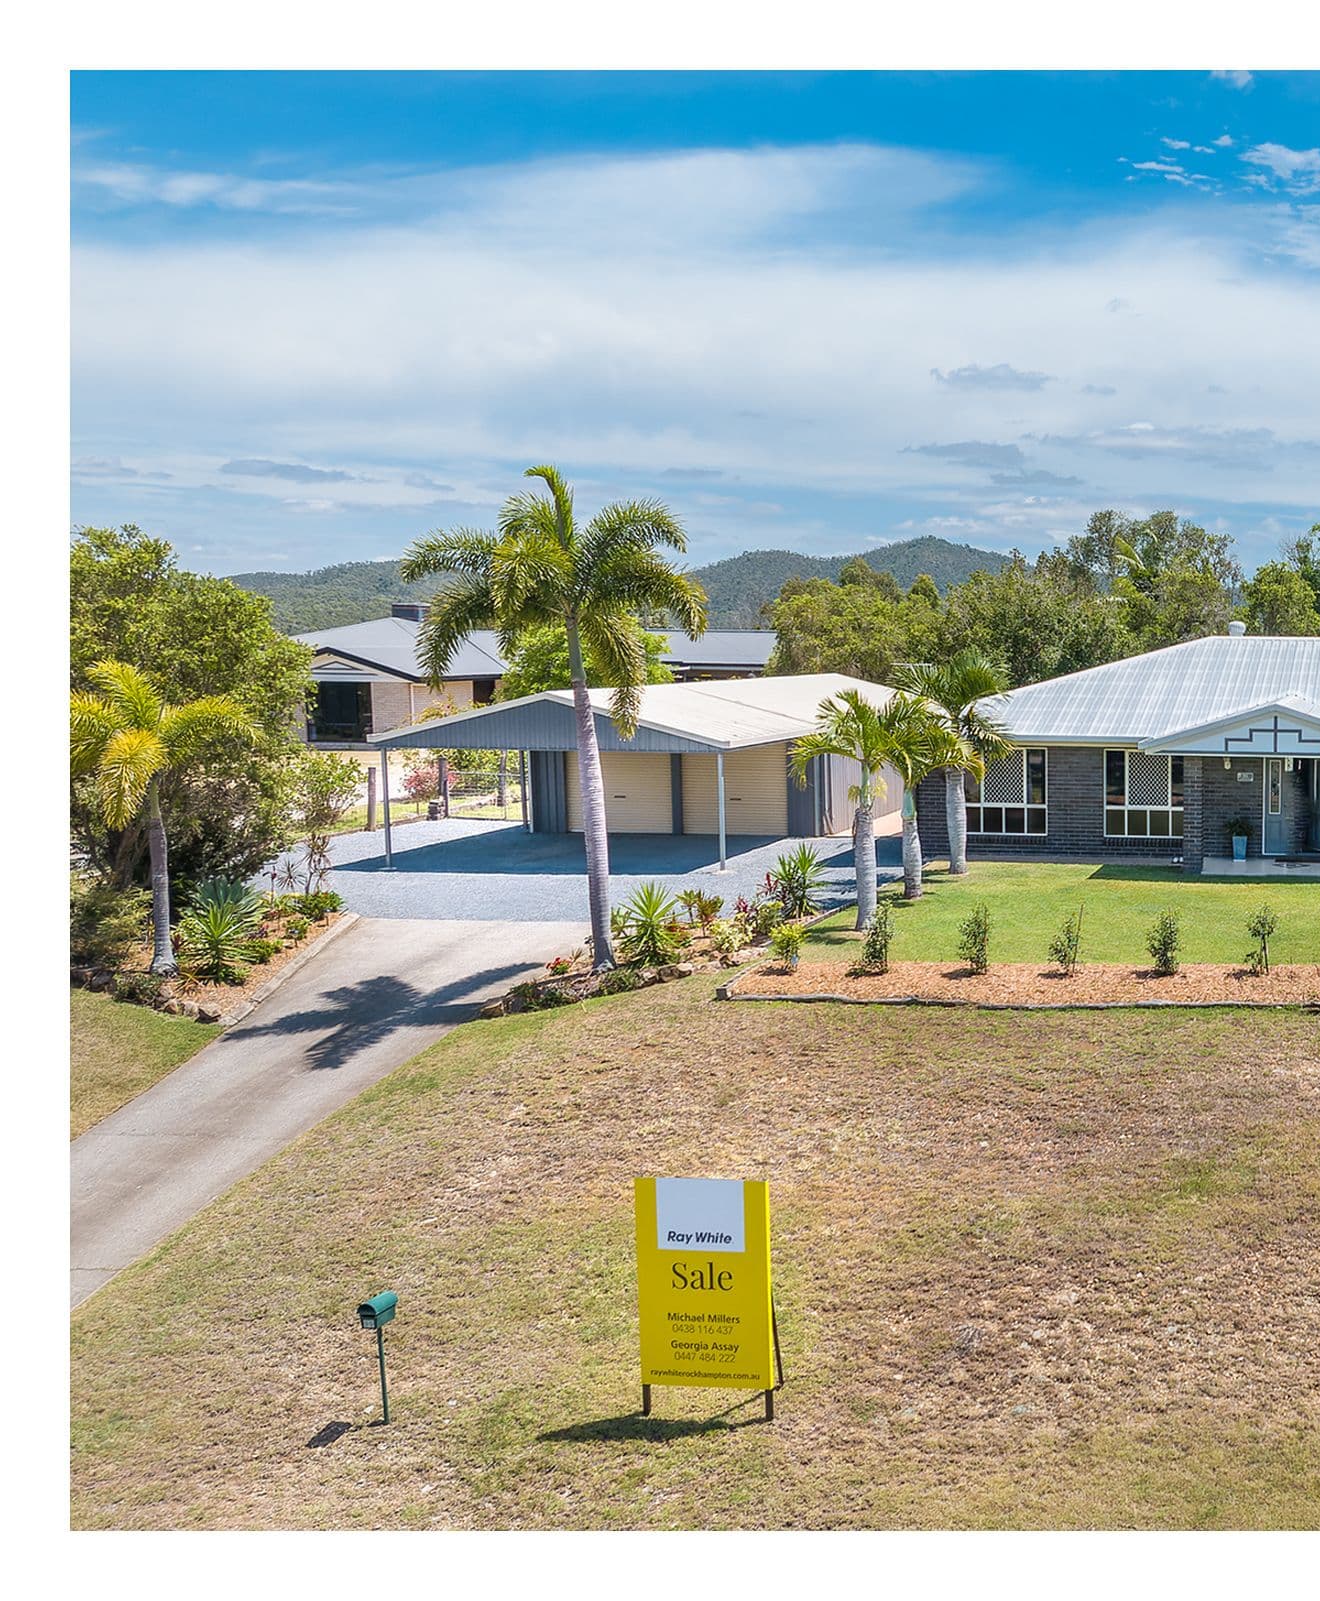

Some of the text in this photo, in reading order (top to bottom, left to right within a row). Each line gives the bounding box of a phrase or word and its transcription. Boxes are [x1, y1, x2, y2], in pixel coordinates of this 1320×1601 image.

[667, 1230, 733, 1244] Ray White
[671, 1261, 734, 1291] Sale
[667, 1312, 741, 1324] Michael Millers
[672, 1323, 733, 1335] 0438 116 437
[671, 1340, 740, 1353] Georgia Assay
[674, 1352, 736, 1363] 0447 484 222
[650, 1369, 760, 1380] raywhiterockhampton.com.au
